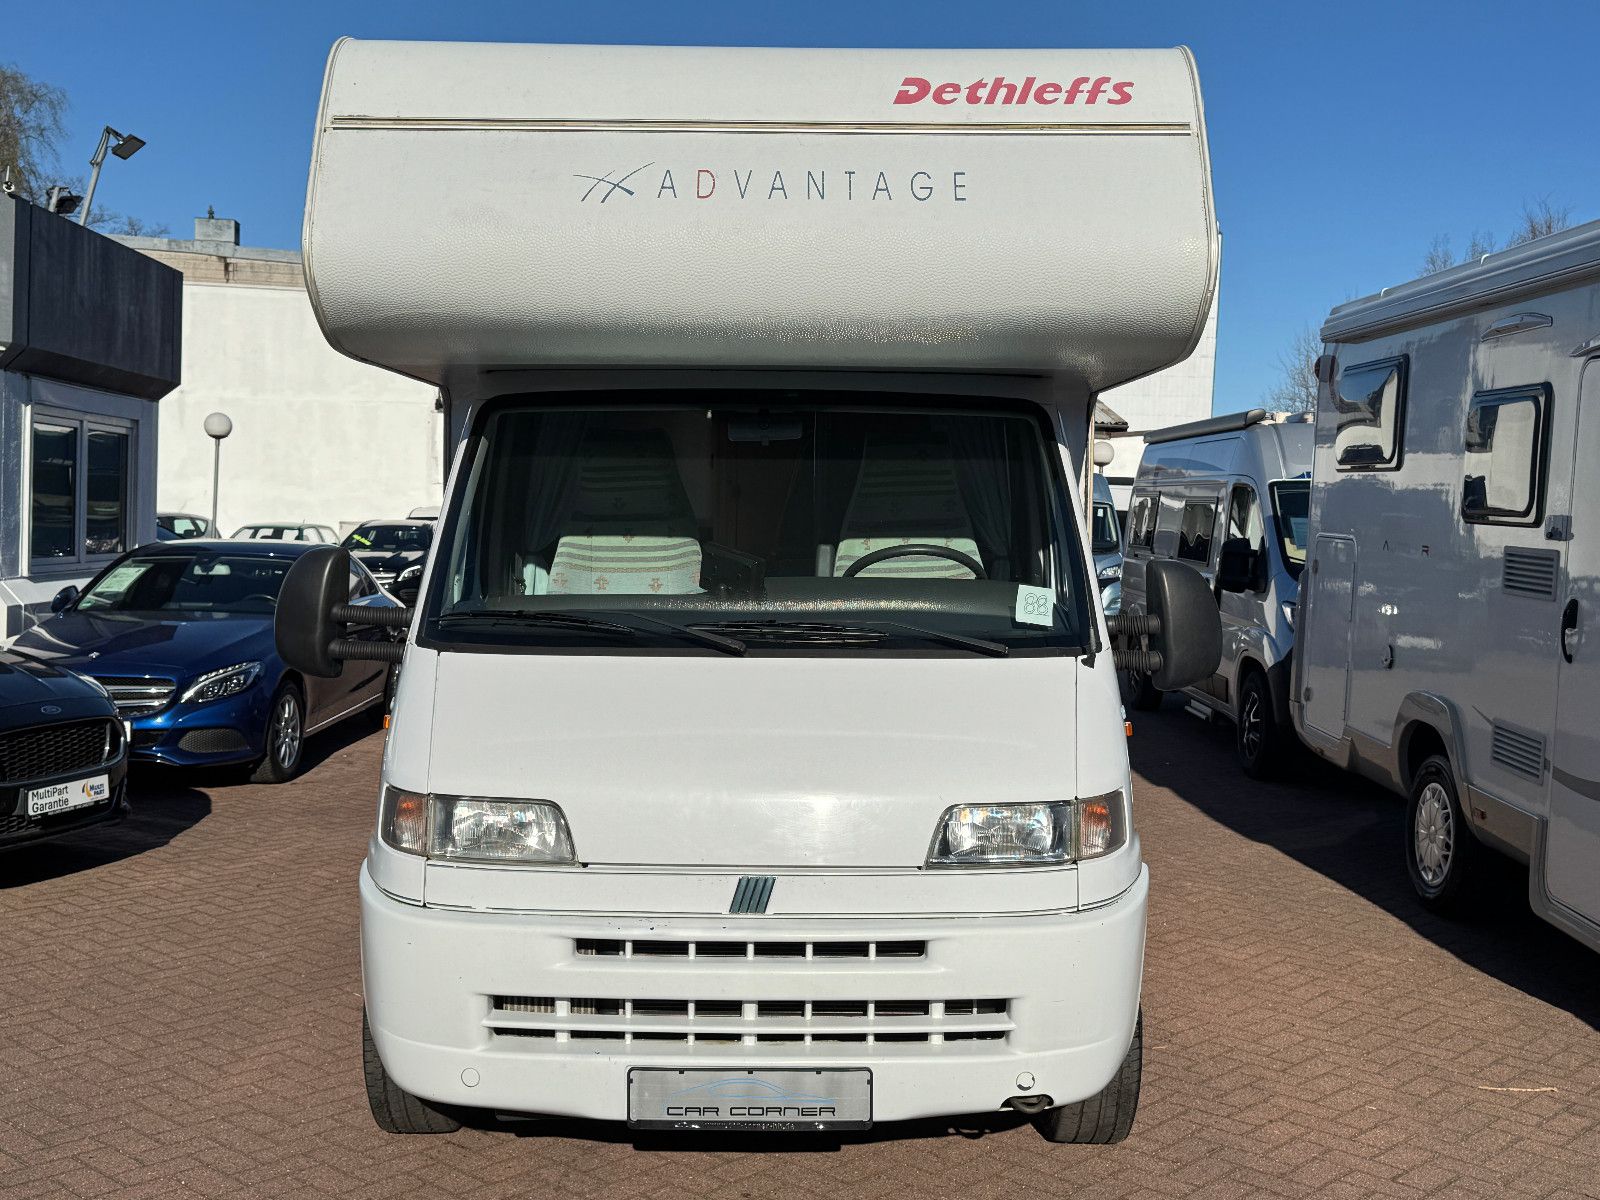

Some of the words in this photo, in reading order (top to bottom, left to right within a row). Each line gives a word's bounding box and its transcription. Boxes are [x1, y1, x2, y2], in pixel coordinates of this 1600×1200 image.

[893, 76, 1135, 105] Dethleffs
[657, 169, 967, 201] ADVANTAGE
[31, 785, 69, 801] MultiPart
[31, 796, 69, 813] Garantie
[666, 1106, 720, 1117] CAR
[729, 1106, 836, 1117] CORNER
